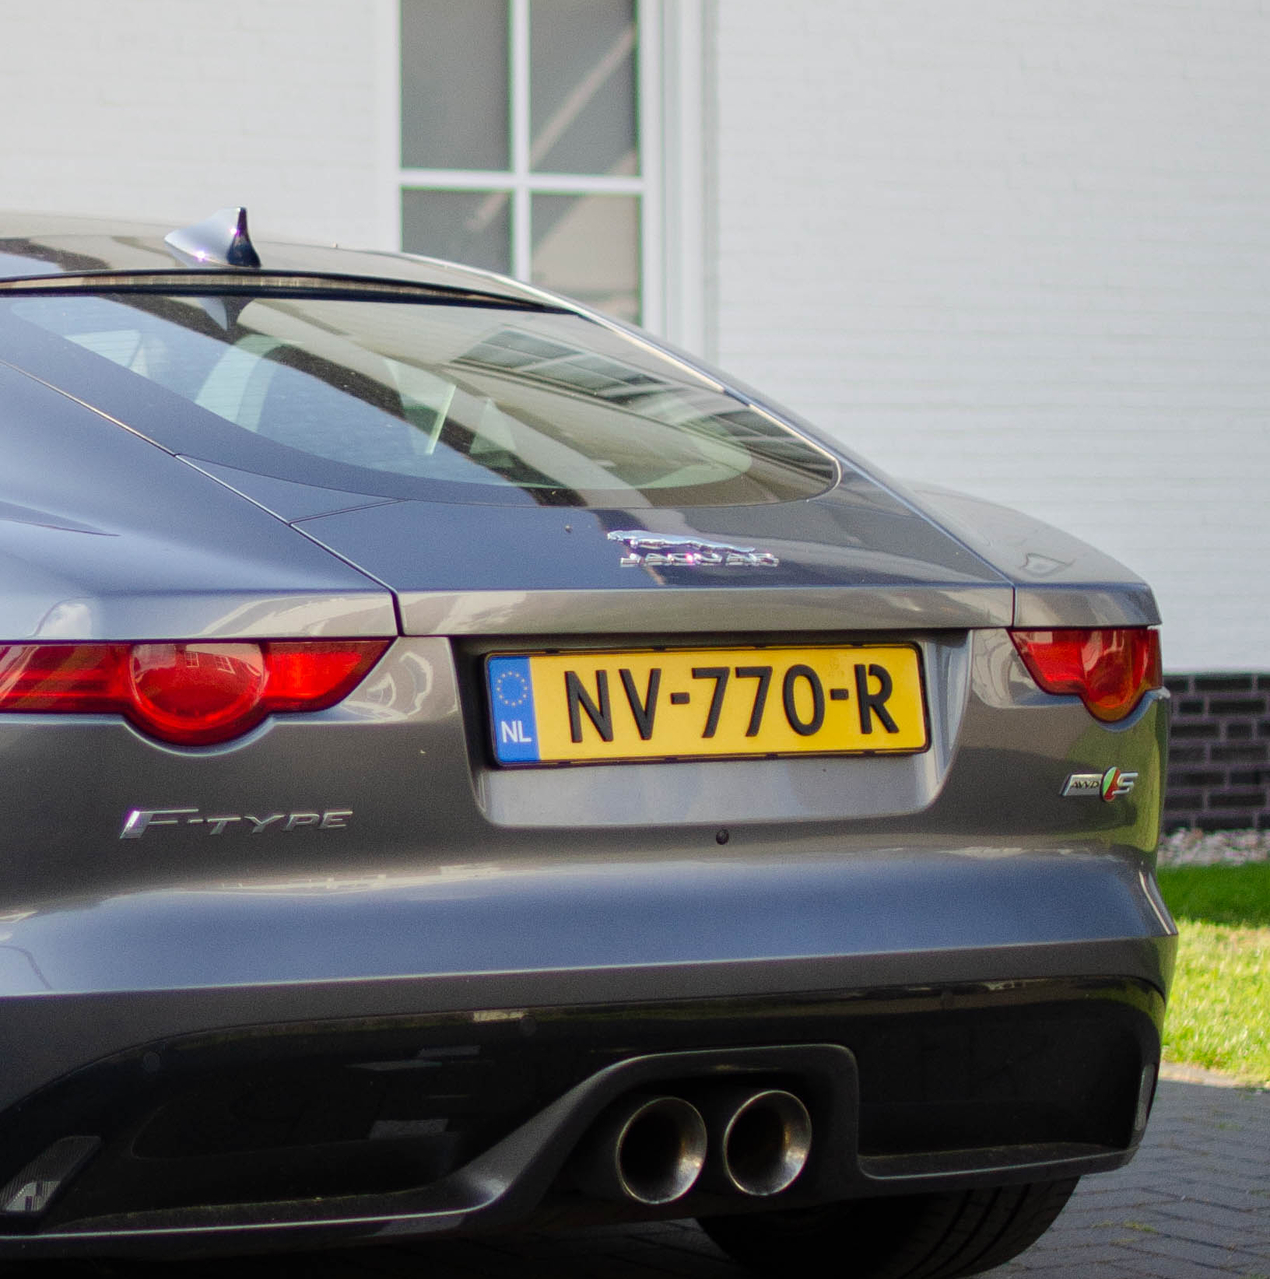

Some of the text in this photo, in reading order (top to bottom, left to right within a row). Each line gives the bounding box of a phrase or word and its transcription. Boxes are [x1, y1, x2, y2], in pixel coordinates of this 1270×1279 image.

[564, 663, 900, 744] NV-770-R
[501, 720, 532, 743] NL
[119, 808, 353, 839] F-TYPE
